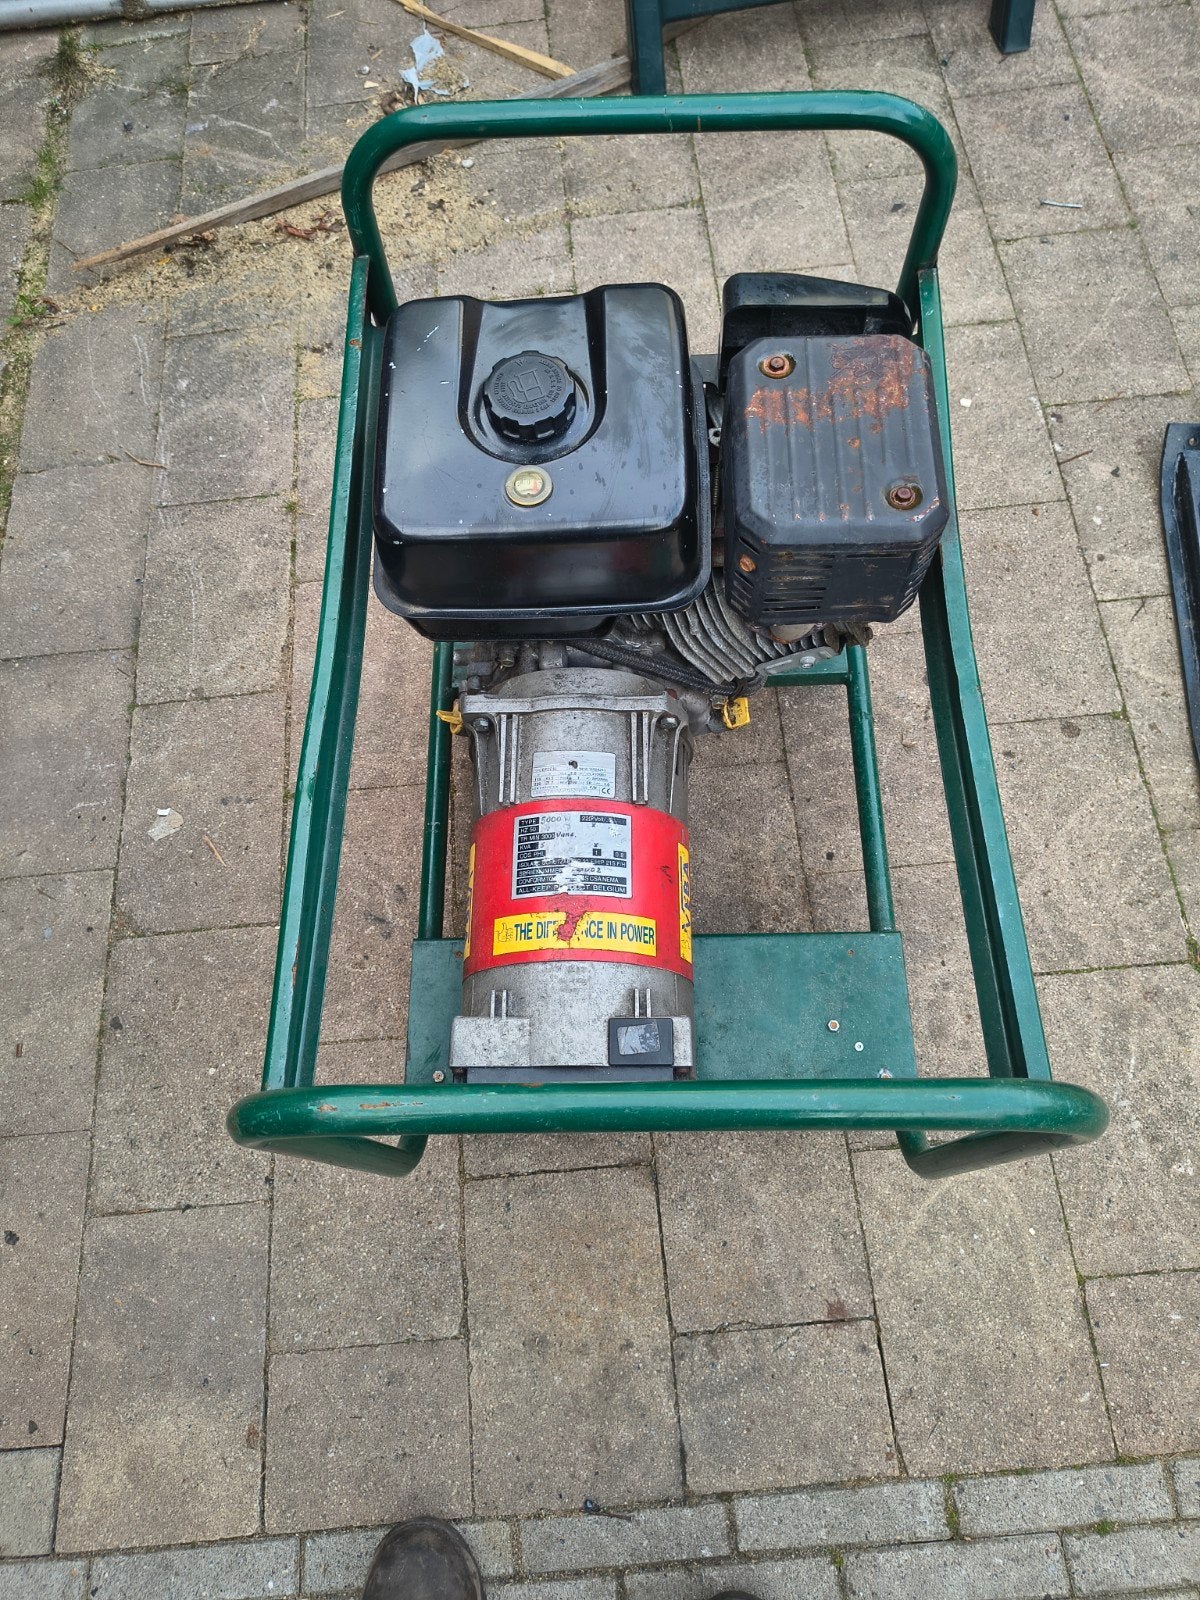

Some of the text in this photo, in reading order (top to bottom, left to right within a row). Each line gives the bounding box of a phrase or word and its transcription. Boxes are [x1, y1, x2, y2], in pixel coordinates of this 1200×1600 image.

[601, 787, 611, 795] CE
[540, 816, 562, 824] 5000
[592, 884, 626, 893] BELGIUM
[514, 922, 533, 941] THE
[607, 920, 618, 940] IN
[620, 923, 655, 946] POWER
